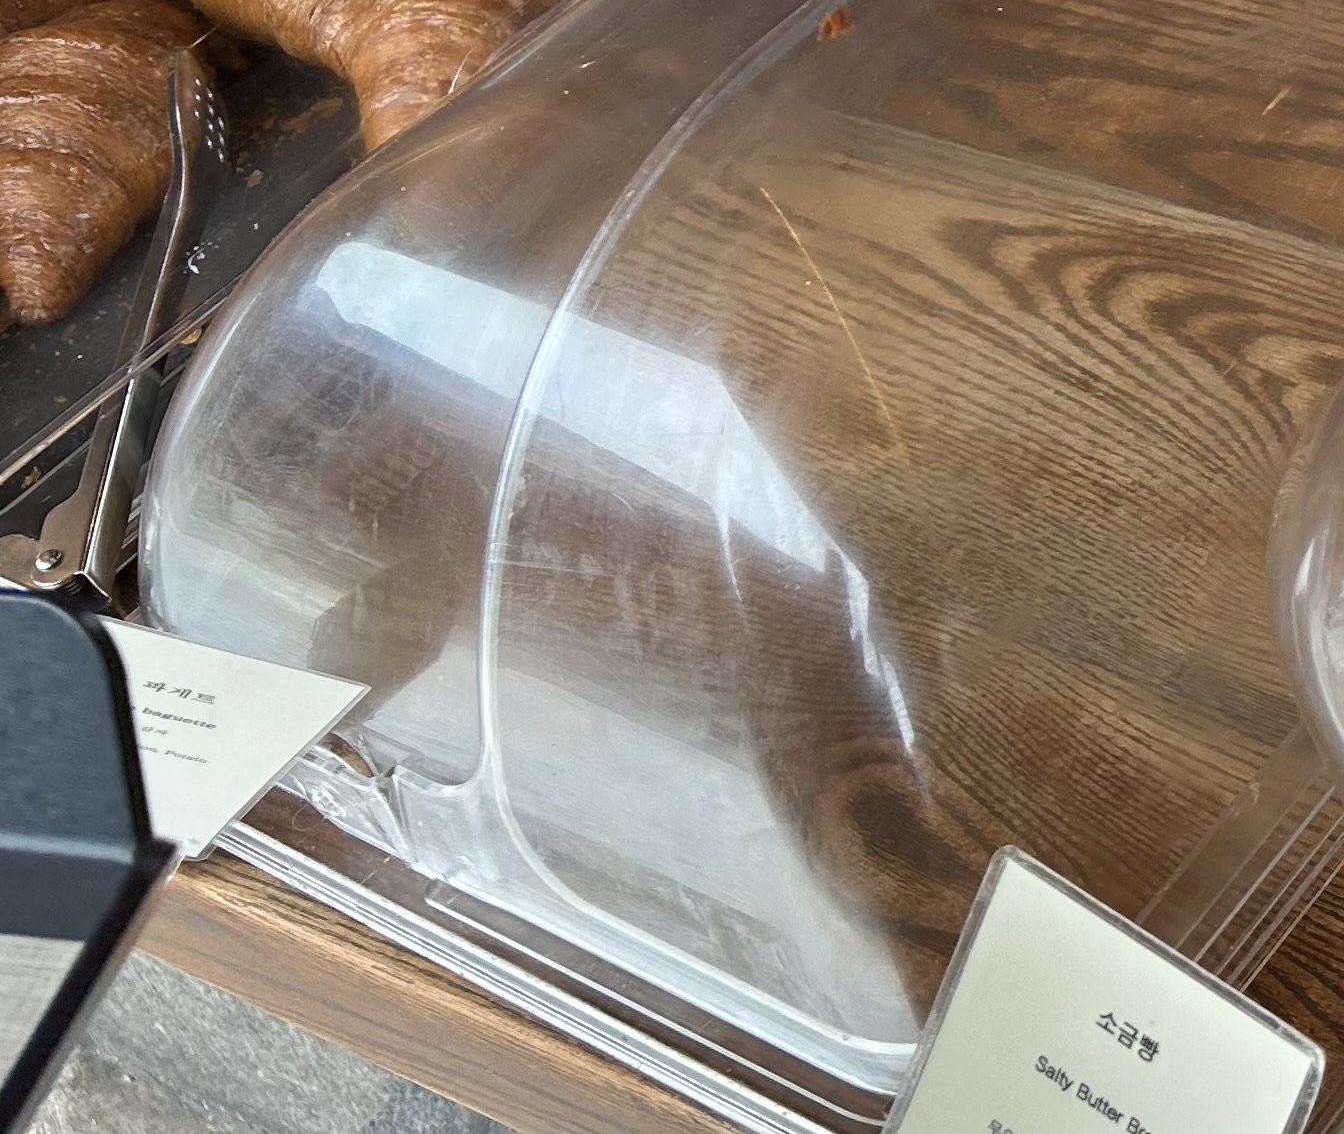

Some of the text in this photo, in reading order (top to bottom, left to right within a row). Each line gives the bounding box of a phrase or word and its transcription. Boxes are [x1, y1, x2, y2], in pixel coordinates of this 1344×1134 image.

[141, 706, 217, 729] baguette
[164, 749, 209, 764] Potato
[1095, 1011, 1161, 1063] 소금빵
[1034, 1055, 1075, 1092] Salty
[1075, 1082, 1125, 1124] Butter
